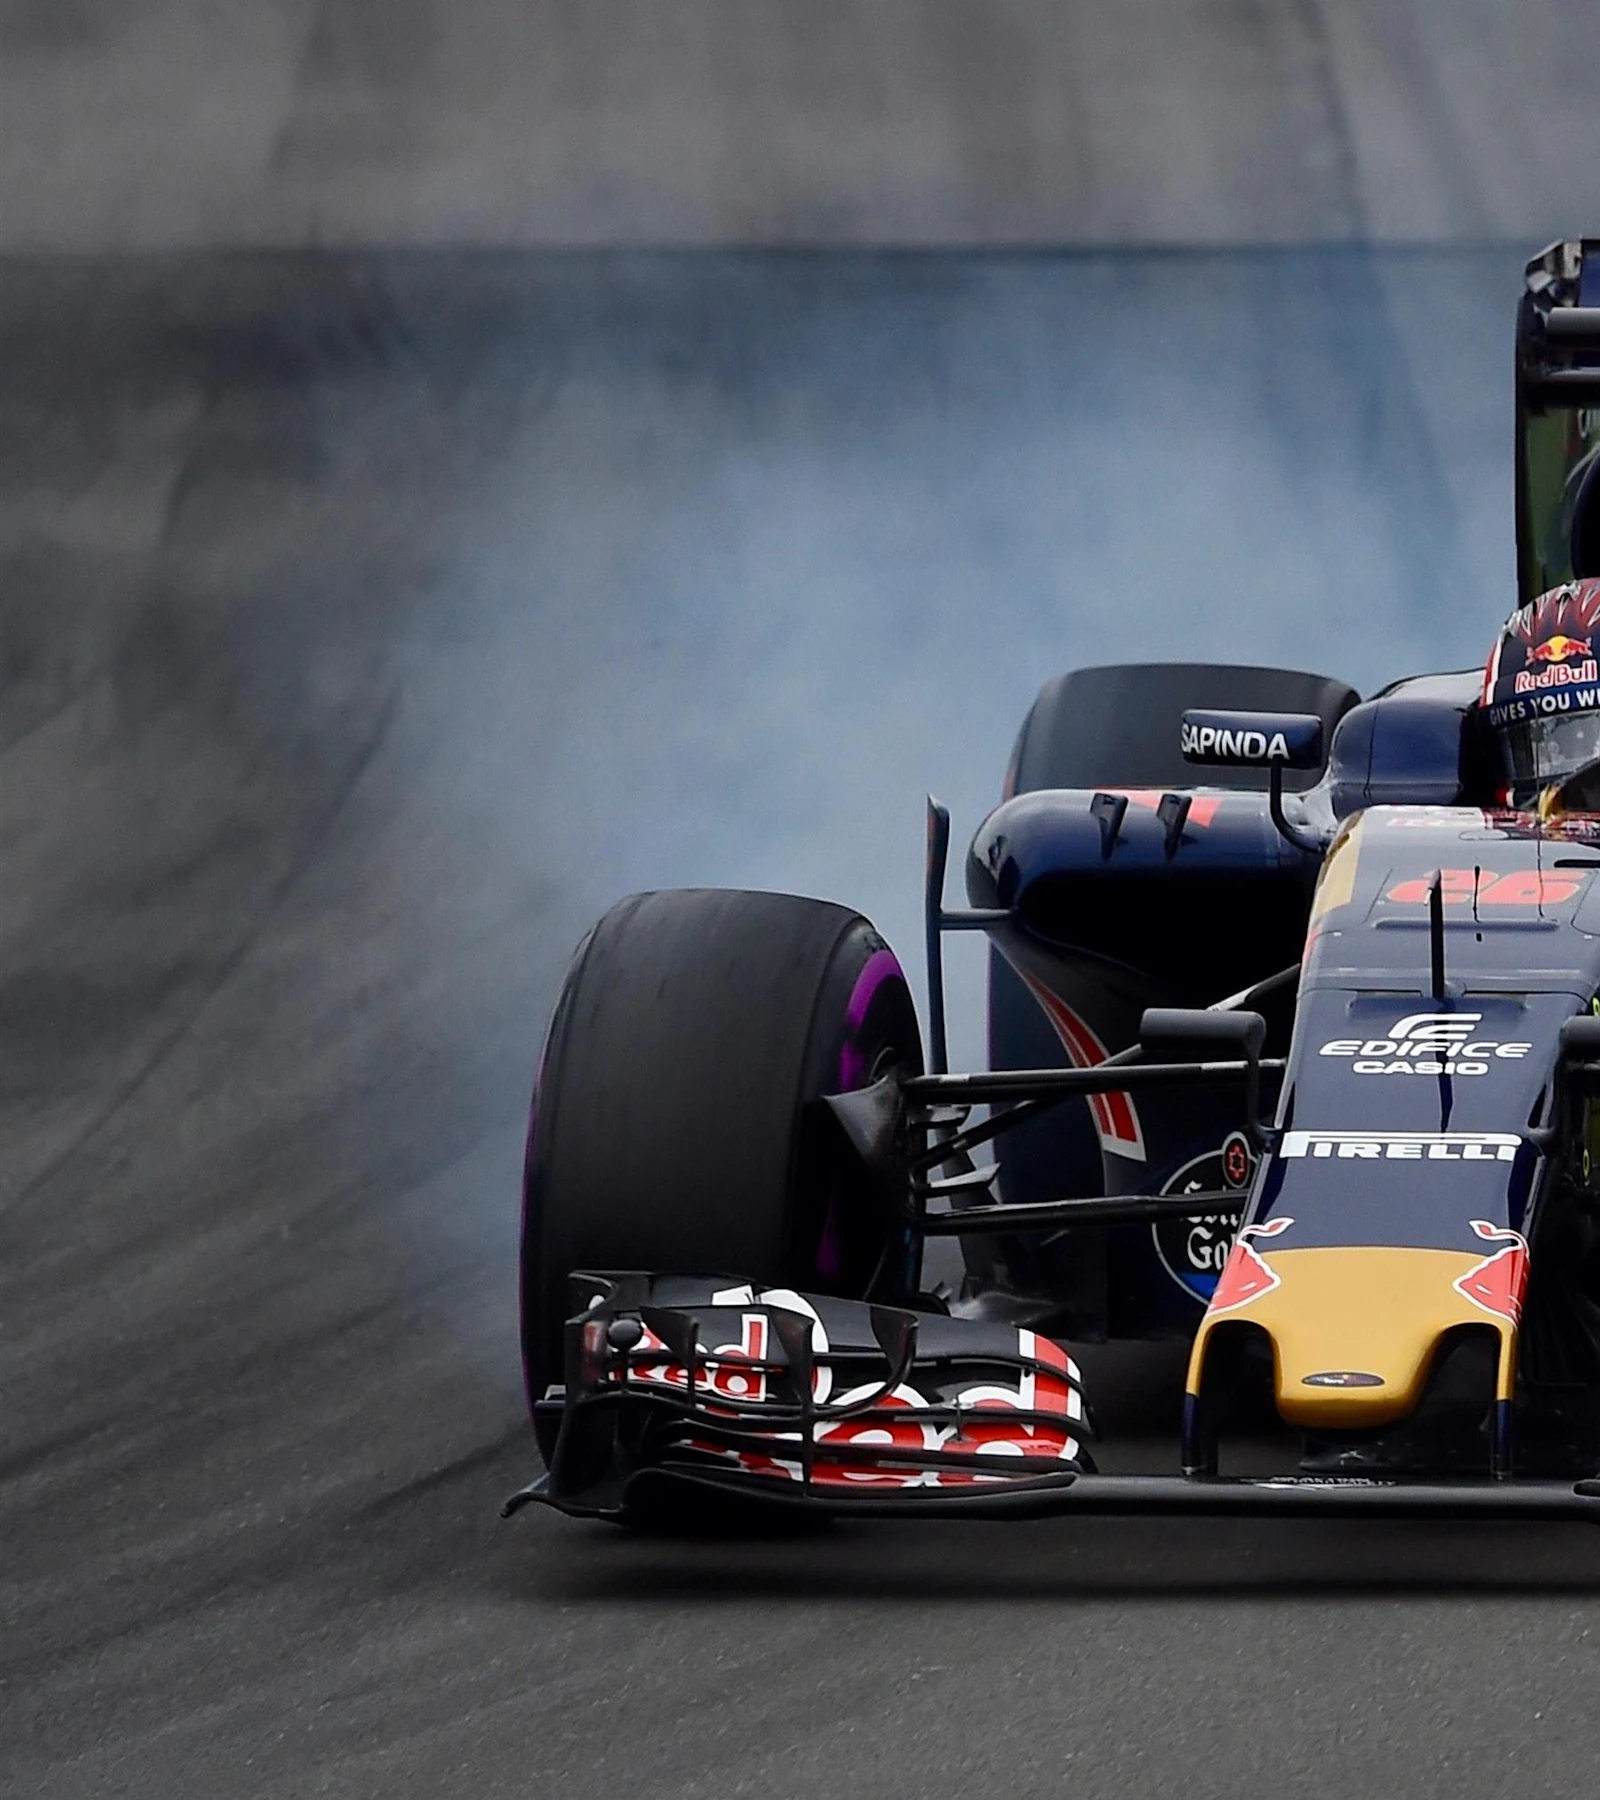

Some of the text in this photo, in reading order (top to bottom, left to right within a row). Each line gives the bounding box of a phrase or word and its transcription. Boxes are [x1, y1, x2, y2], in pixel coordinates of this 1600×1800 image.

[1489, 701, 1526, 726] GIVES
[1530, 691, 1570, 714] YOU
[1181, 723, 1290, 760] SAPINDA
[1319, 1040, 1533, 1058] EDIFICE
[1353, 1061, 1489, 1075] CASIO
[1279, 1131, 1522, 1162] PIRELLI
